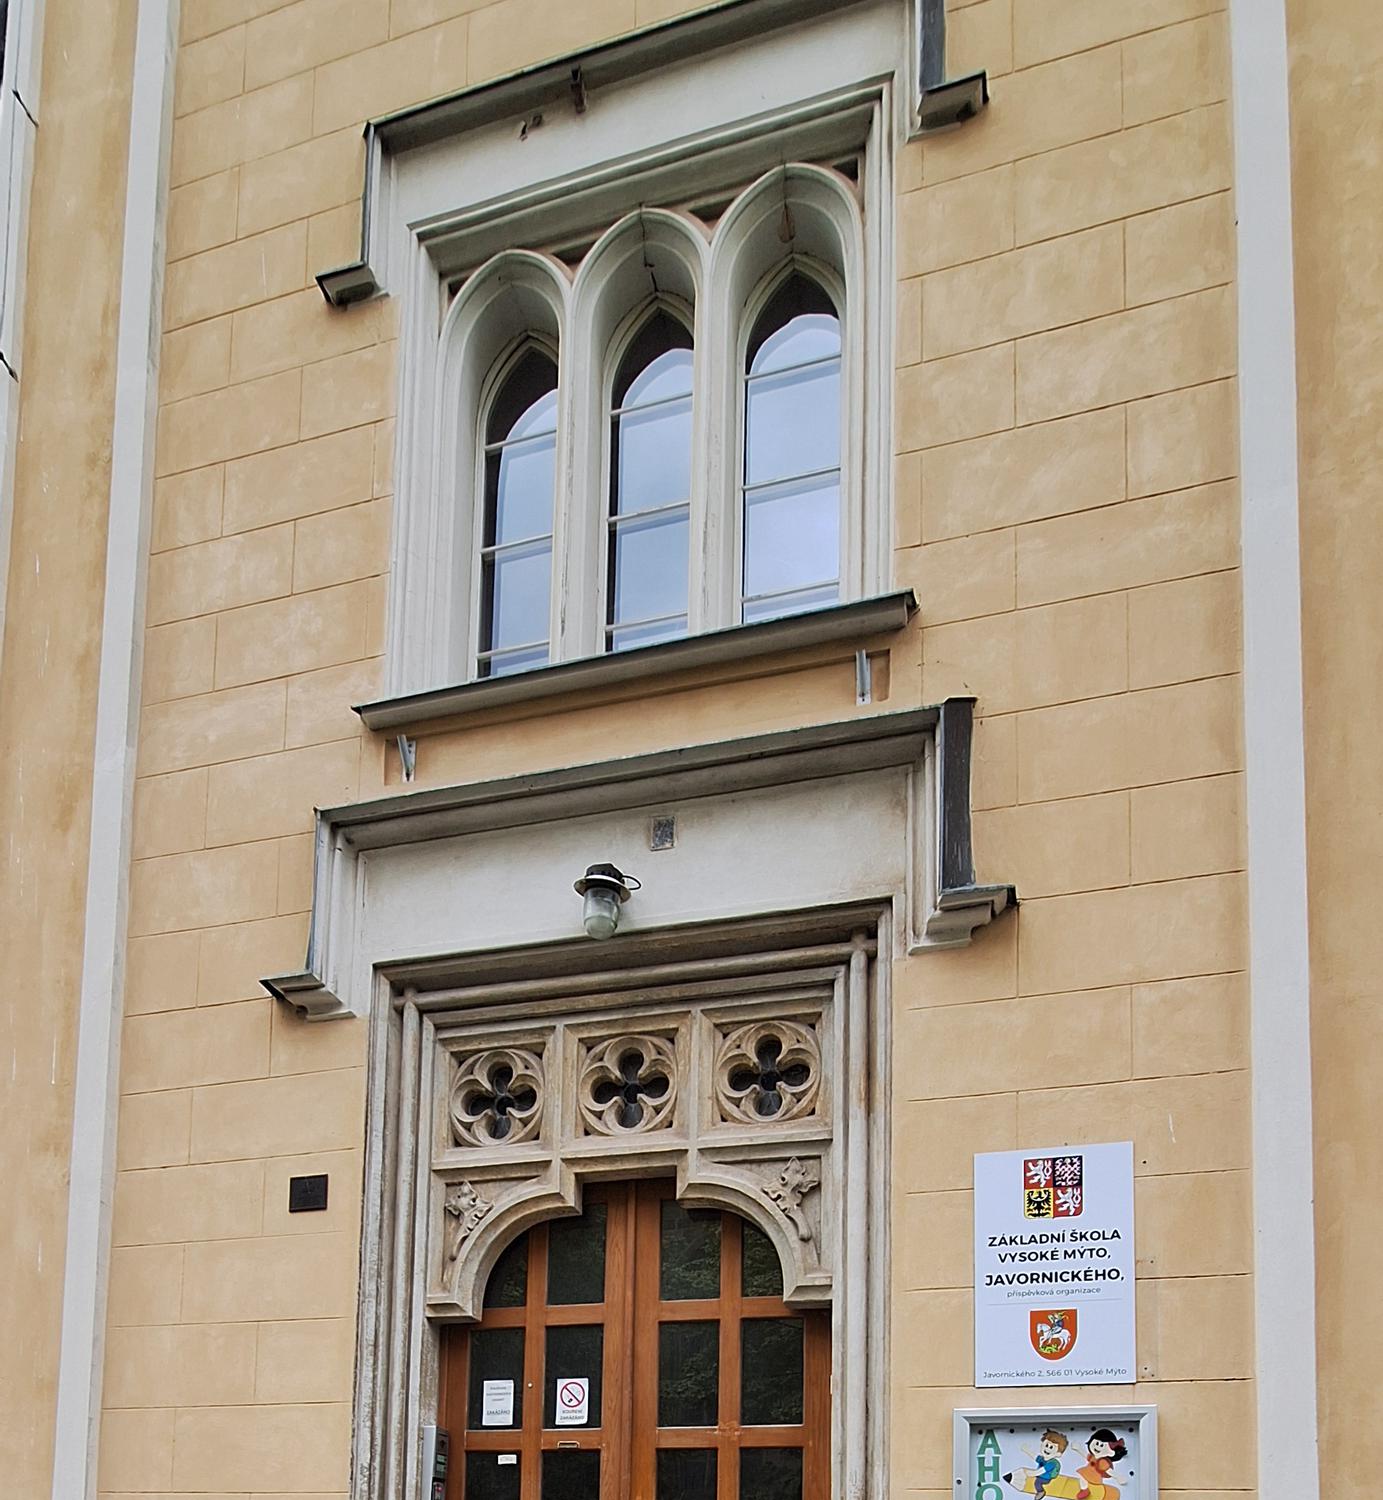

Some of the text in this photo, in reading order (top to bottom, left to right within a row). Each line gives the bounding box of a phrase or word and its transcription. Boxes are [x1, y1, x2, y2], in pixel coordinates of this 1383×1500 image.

[988, 1229, 1121, 1247] ZÁKLADNÍ ŠKOLA
[998, 1246, 1111, 1263] VYSOKÉ MÝTO,
[985, 1267, 1124, 1286] JAVORNICKÉHO,
[1007, 1286, 1101, 1298] příspěvková organizace
[983, 1369, 1035, 1379] Javornického
[1075, 1368, 1103, 1377] Vysoké
[1105, 1367, 1127, 1376] Mýto
